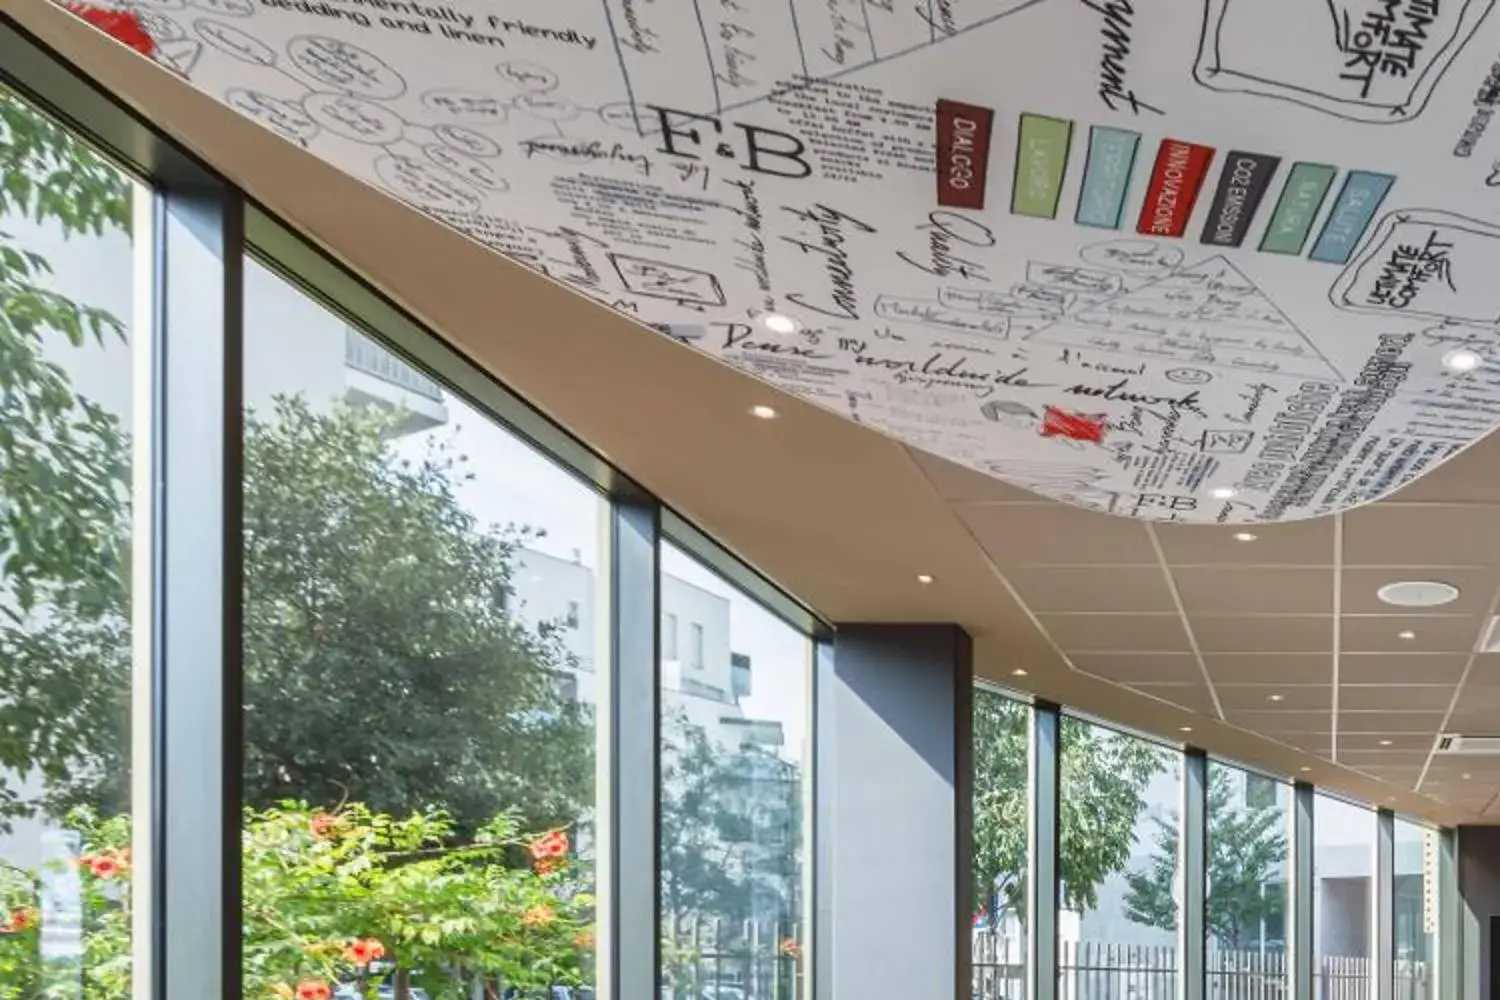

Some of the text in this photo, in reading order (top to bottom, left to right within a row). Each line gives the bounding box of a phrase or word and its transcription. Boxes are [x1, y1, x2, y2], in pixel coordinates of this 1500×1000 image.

[379, 16, 432, 35] and
[440, 22, 506, 48] linen
[487, 14, 597, 50] friendly
